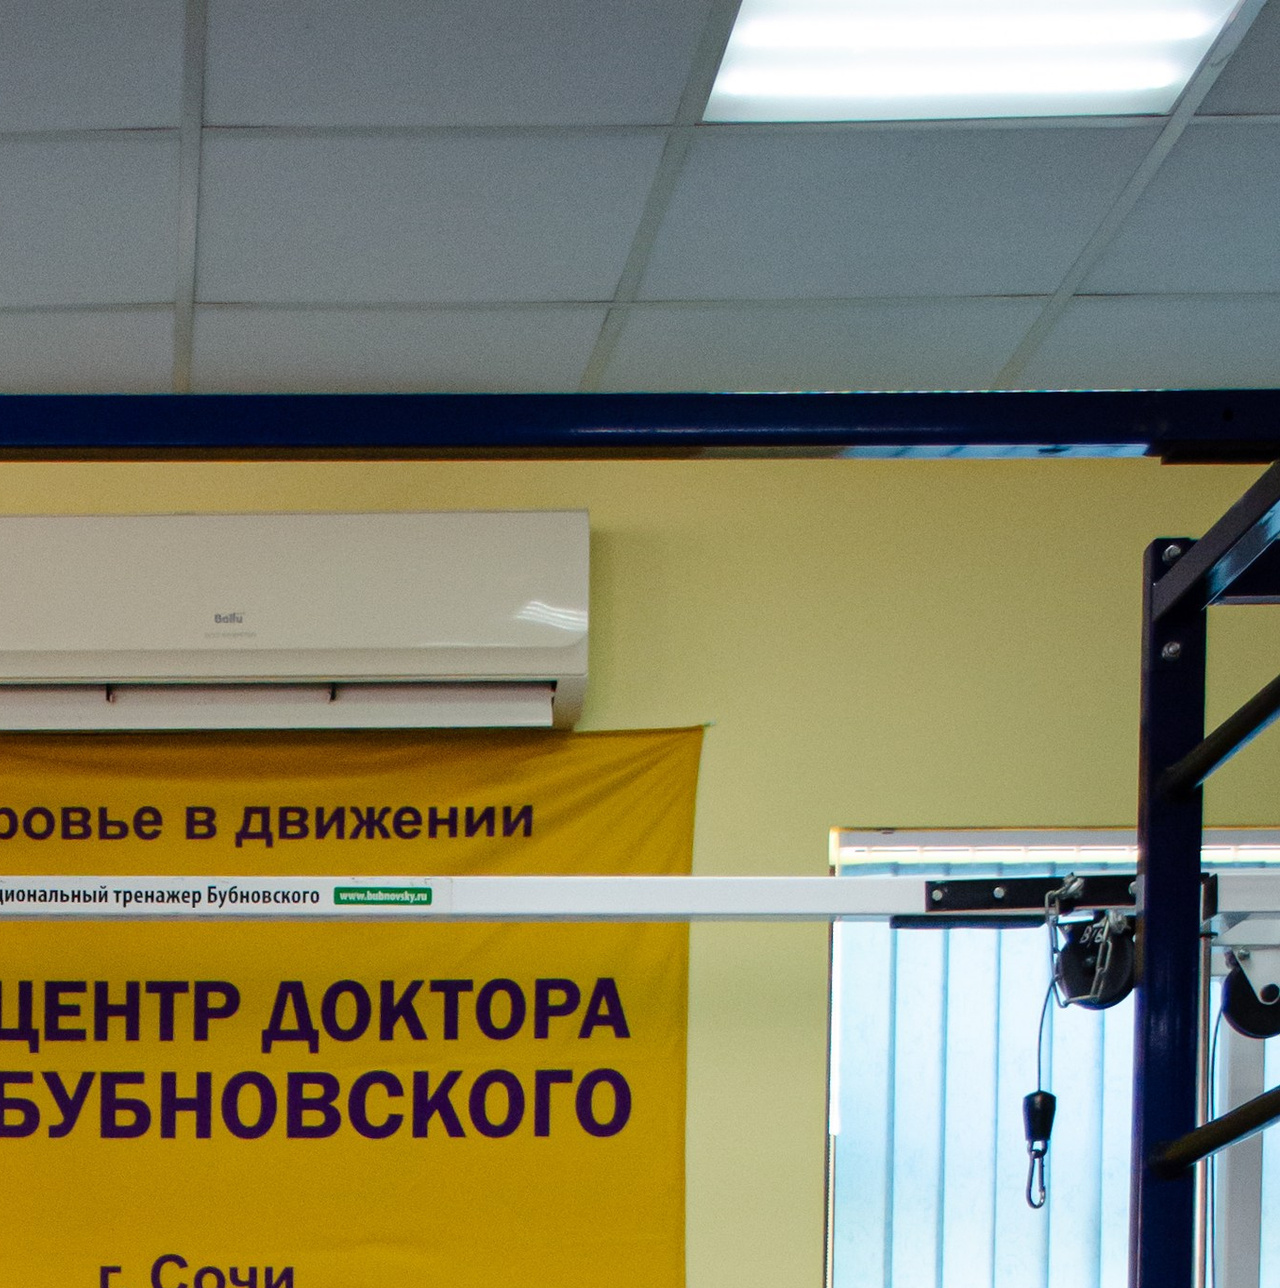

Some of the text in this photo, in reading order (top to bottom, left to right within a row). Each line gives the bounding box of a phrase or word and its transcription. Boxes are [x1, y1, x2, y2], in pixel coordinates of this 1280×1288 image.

[186, 807, 219, 841] в
[235, 805, 535, 849] движении
[114, 890, 202, 908] тренажер
[208, 884, 320, 908] Бубновского
[339, 890, 428, 904] www.bubnovsky.ru
[262, 977, 632, 1055] ДОКТОРА
